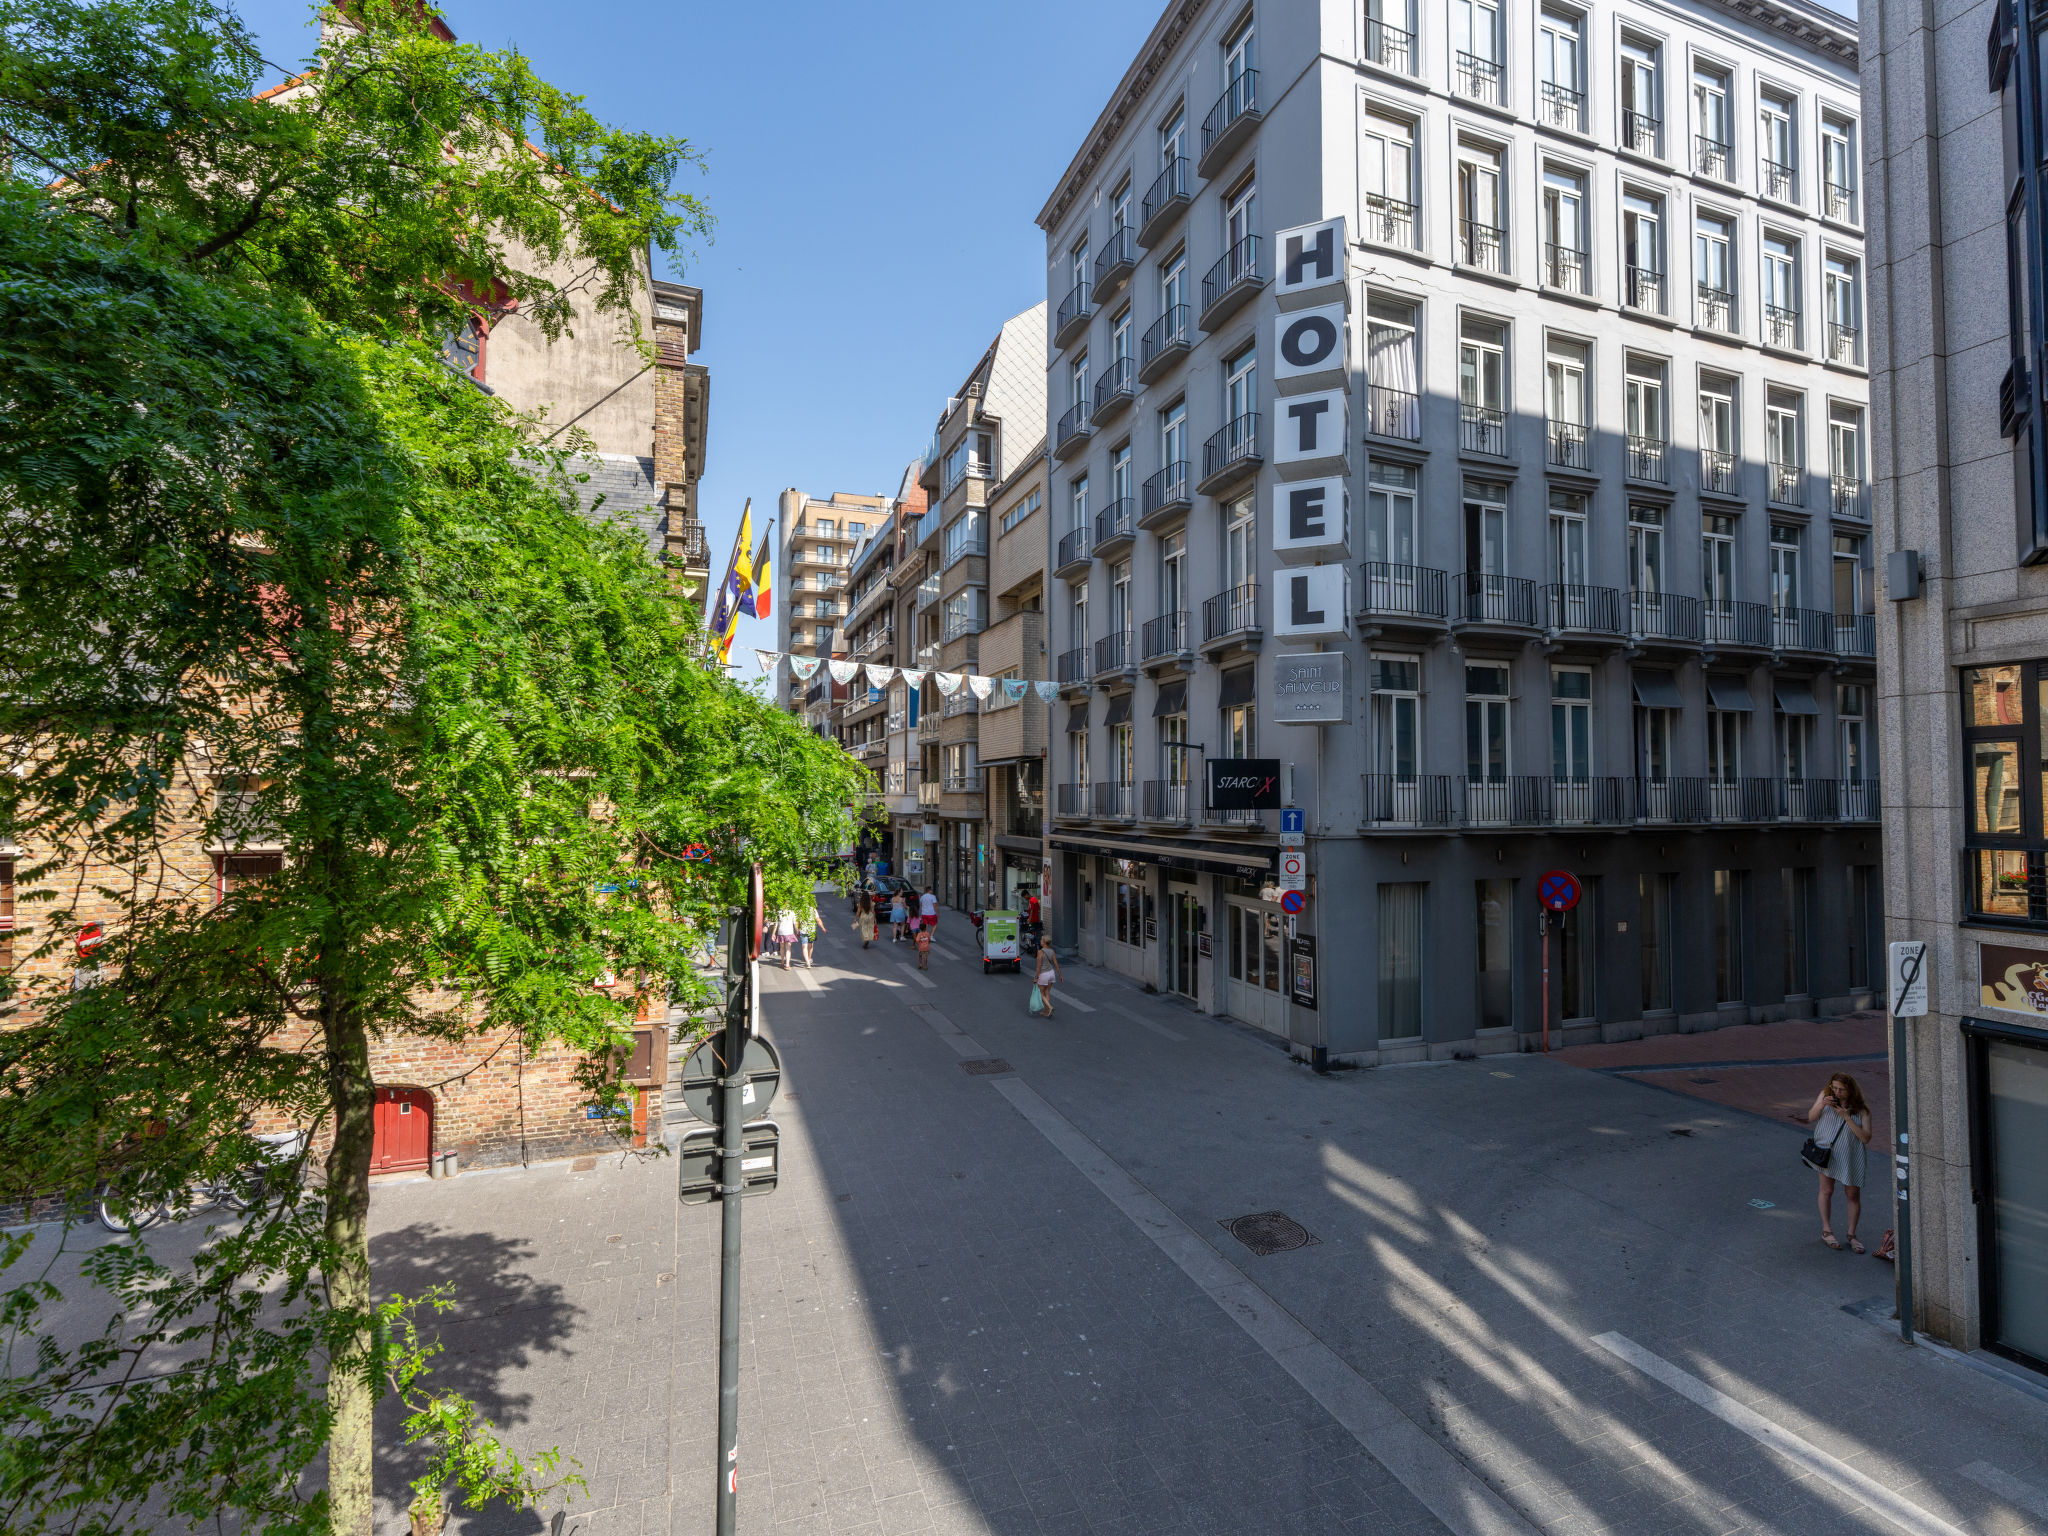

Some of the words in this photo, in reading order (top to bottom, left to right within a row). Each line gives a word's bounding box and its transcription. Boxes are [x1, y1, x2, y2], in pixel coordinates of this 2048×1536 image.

[1281, 228, 1337, 626] HOTEL
[1276, 680, 1342, 697] SAUVEUR
[1900, 946, 1920, 956] ZONE
